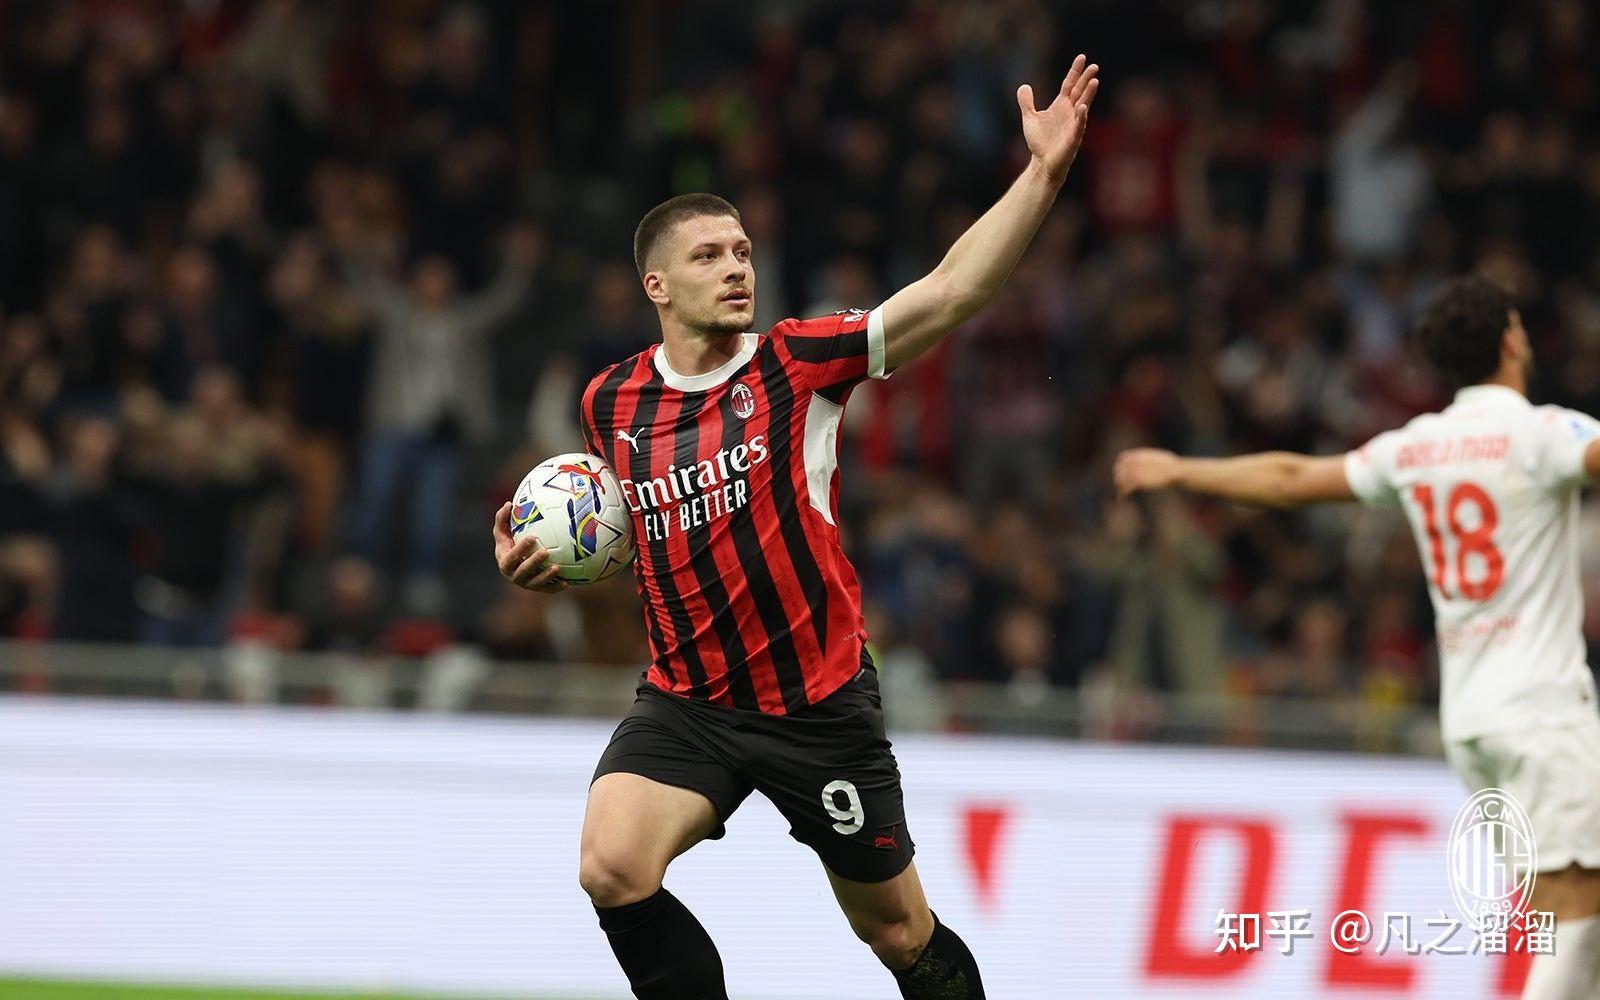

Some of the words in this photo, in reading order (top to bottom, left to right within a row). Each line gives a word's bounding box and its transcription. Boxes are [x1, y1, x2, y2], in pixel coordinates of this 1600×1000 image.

[620, 435, 768, 512] Emirates
[644, 510, 671, 542] FLY
[678, 478, 748, 532] BETTER
[1412, 481, 1505, 602] 18
[821, 779, 865, 835] 9
